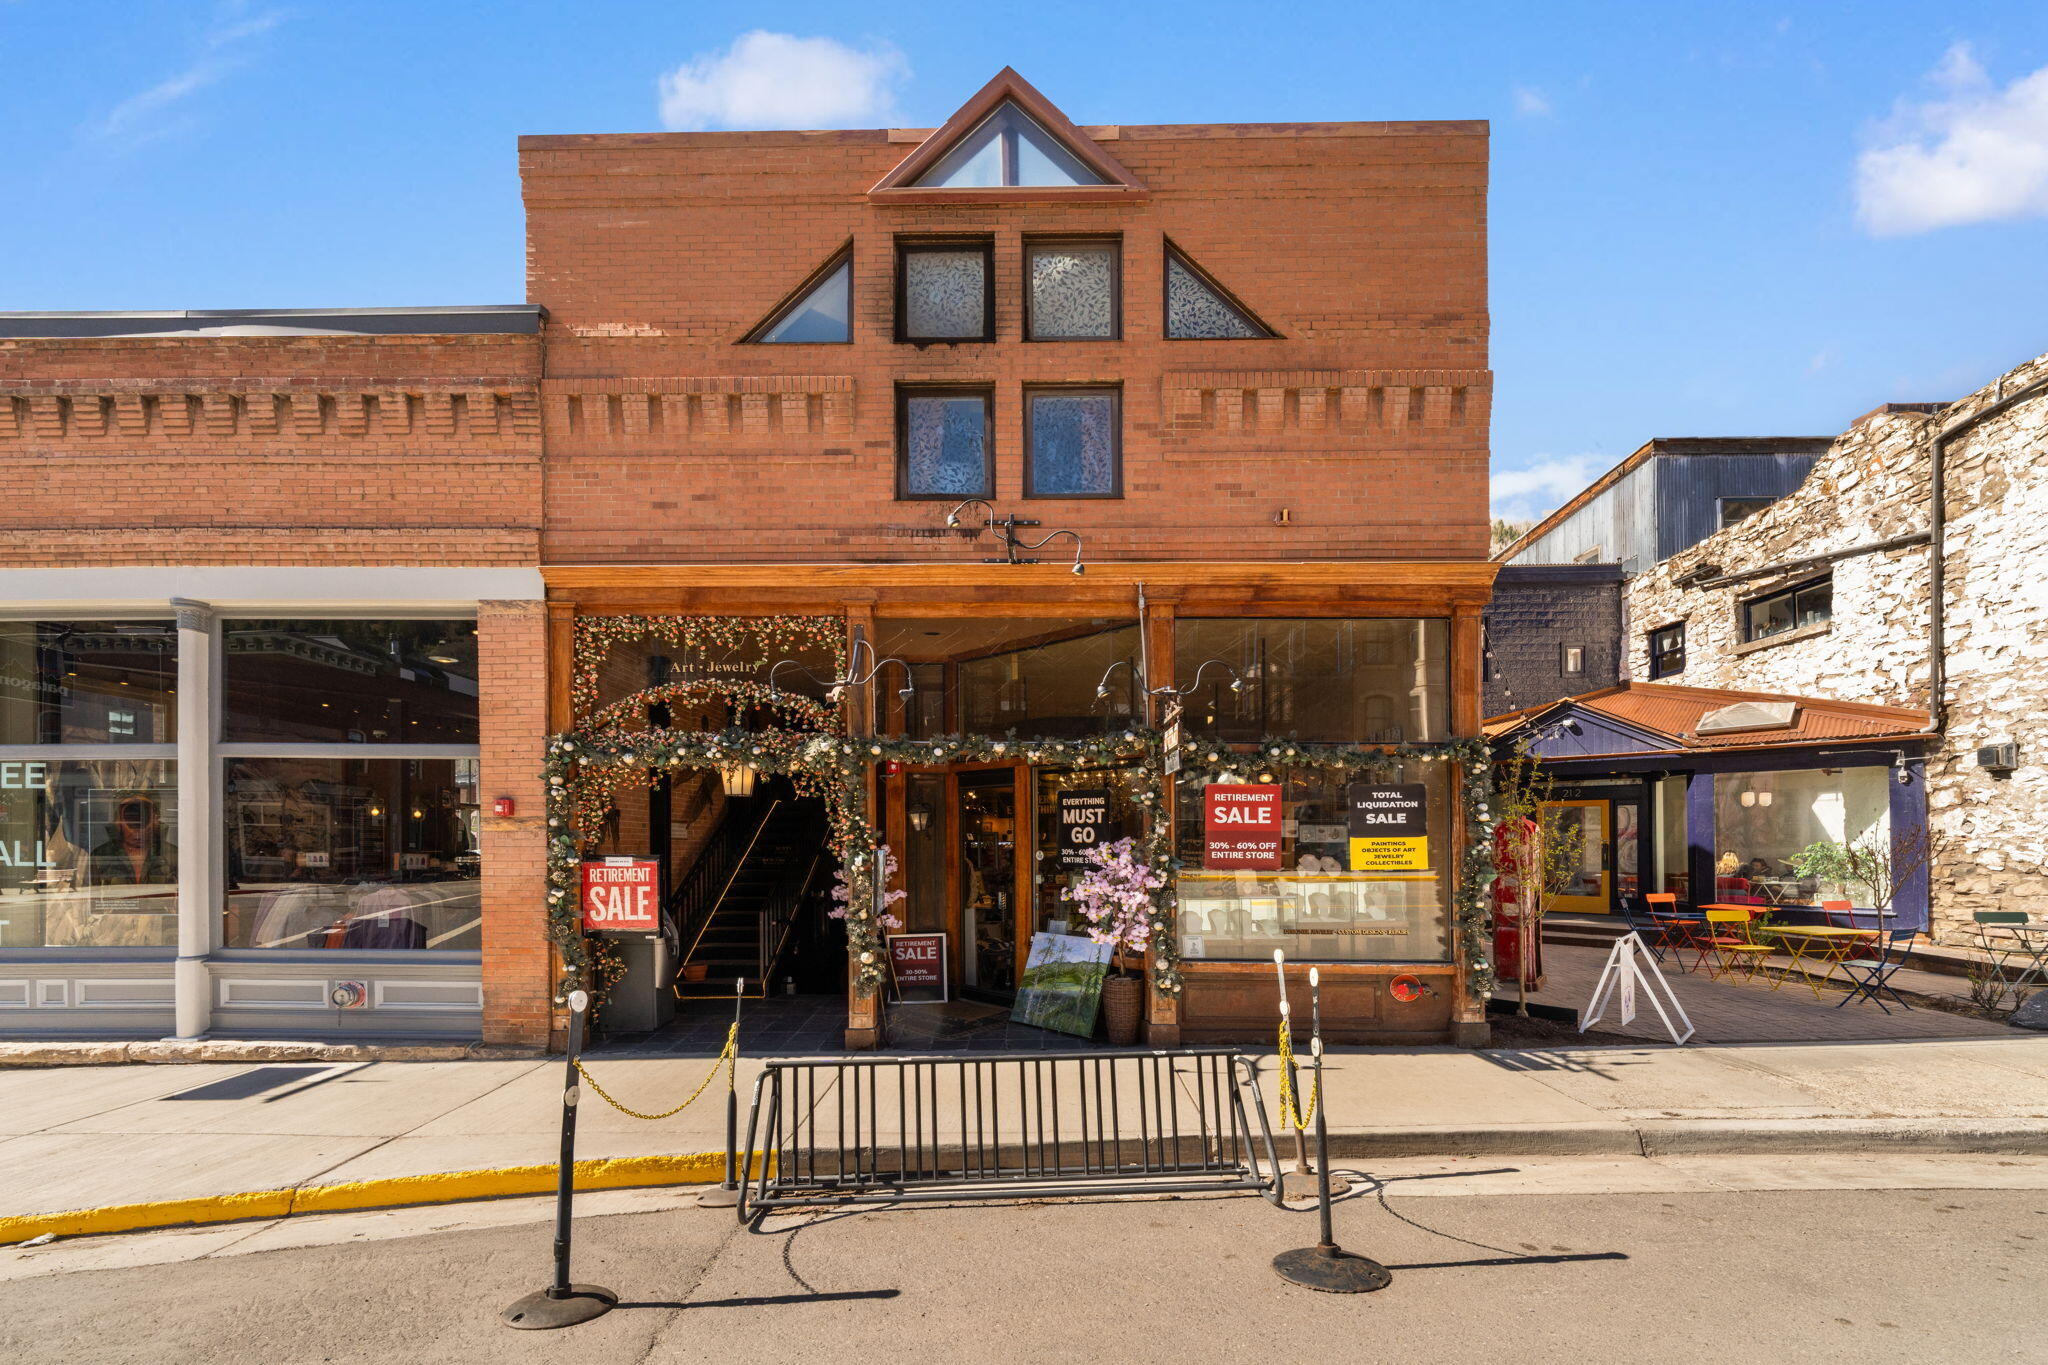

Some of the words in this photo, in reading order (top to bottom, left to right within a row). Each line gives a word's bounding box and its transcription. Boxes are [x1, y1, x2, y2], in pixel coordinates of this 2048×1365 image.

[670, 661, 695, 673] Art
[706, 661, 760, 674] Jewelry
[1214, 793, 1274, 802] RETIREMENT
[1372, 791, 1403, 799] TOTAL
[1562, 788, 1583, 798] 212
[1063, 797, 1105, 805] EVERYTHING
[1357, 801, 1419, 809] LIQUIDATION
[1062, 808, 1105, 824] MUST
[1214, 806, 1272, 824] SALE
[1366, 813, 1407, 824] SALE
[1071, 826, 1096, 844] GO
[1209, 842, 1230, 850] 30%
[1236, 842, 1257, 850] 60%
[1258, 842, 1277, 850] OFF
[1061, 848, 1075, 856] 30%
[1211, 851, 1244, 859] ENTIRE
[1245, 851, 1275, 859] STORE
[589, 868, 651, 883] RETIREMENT
[589, 886, 652, 922] SALE
[896, 947, 936, 960] SALE
